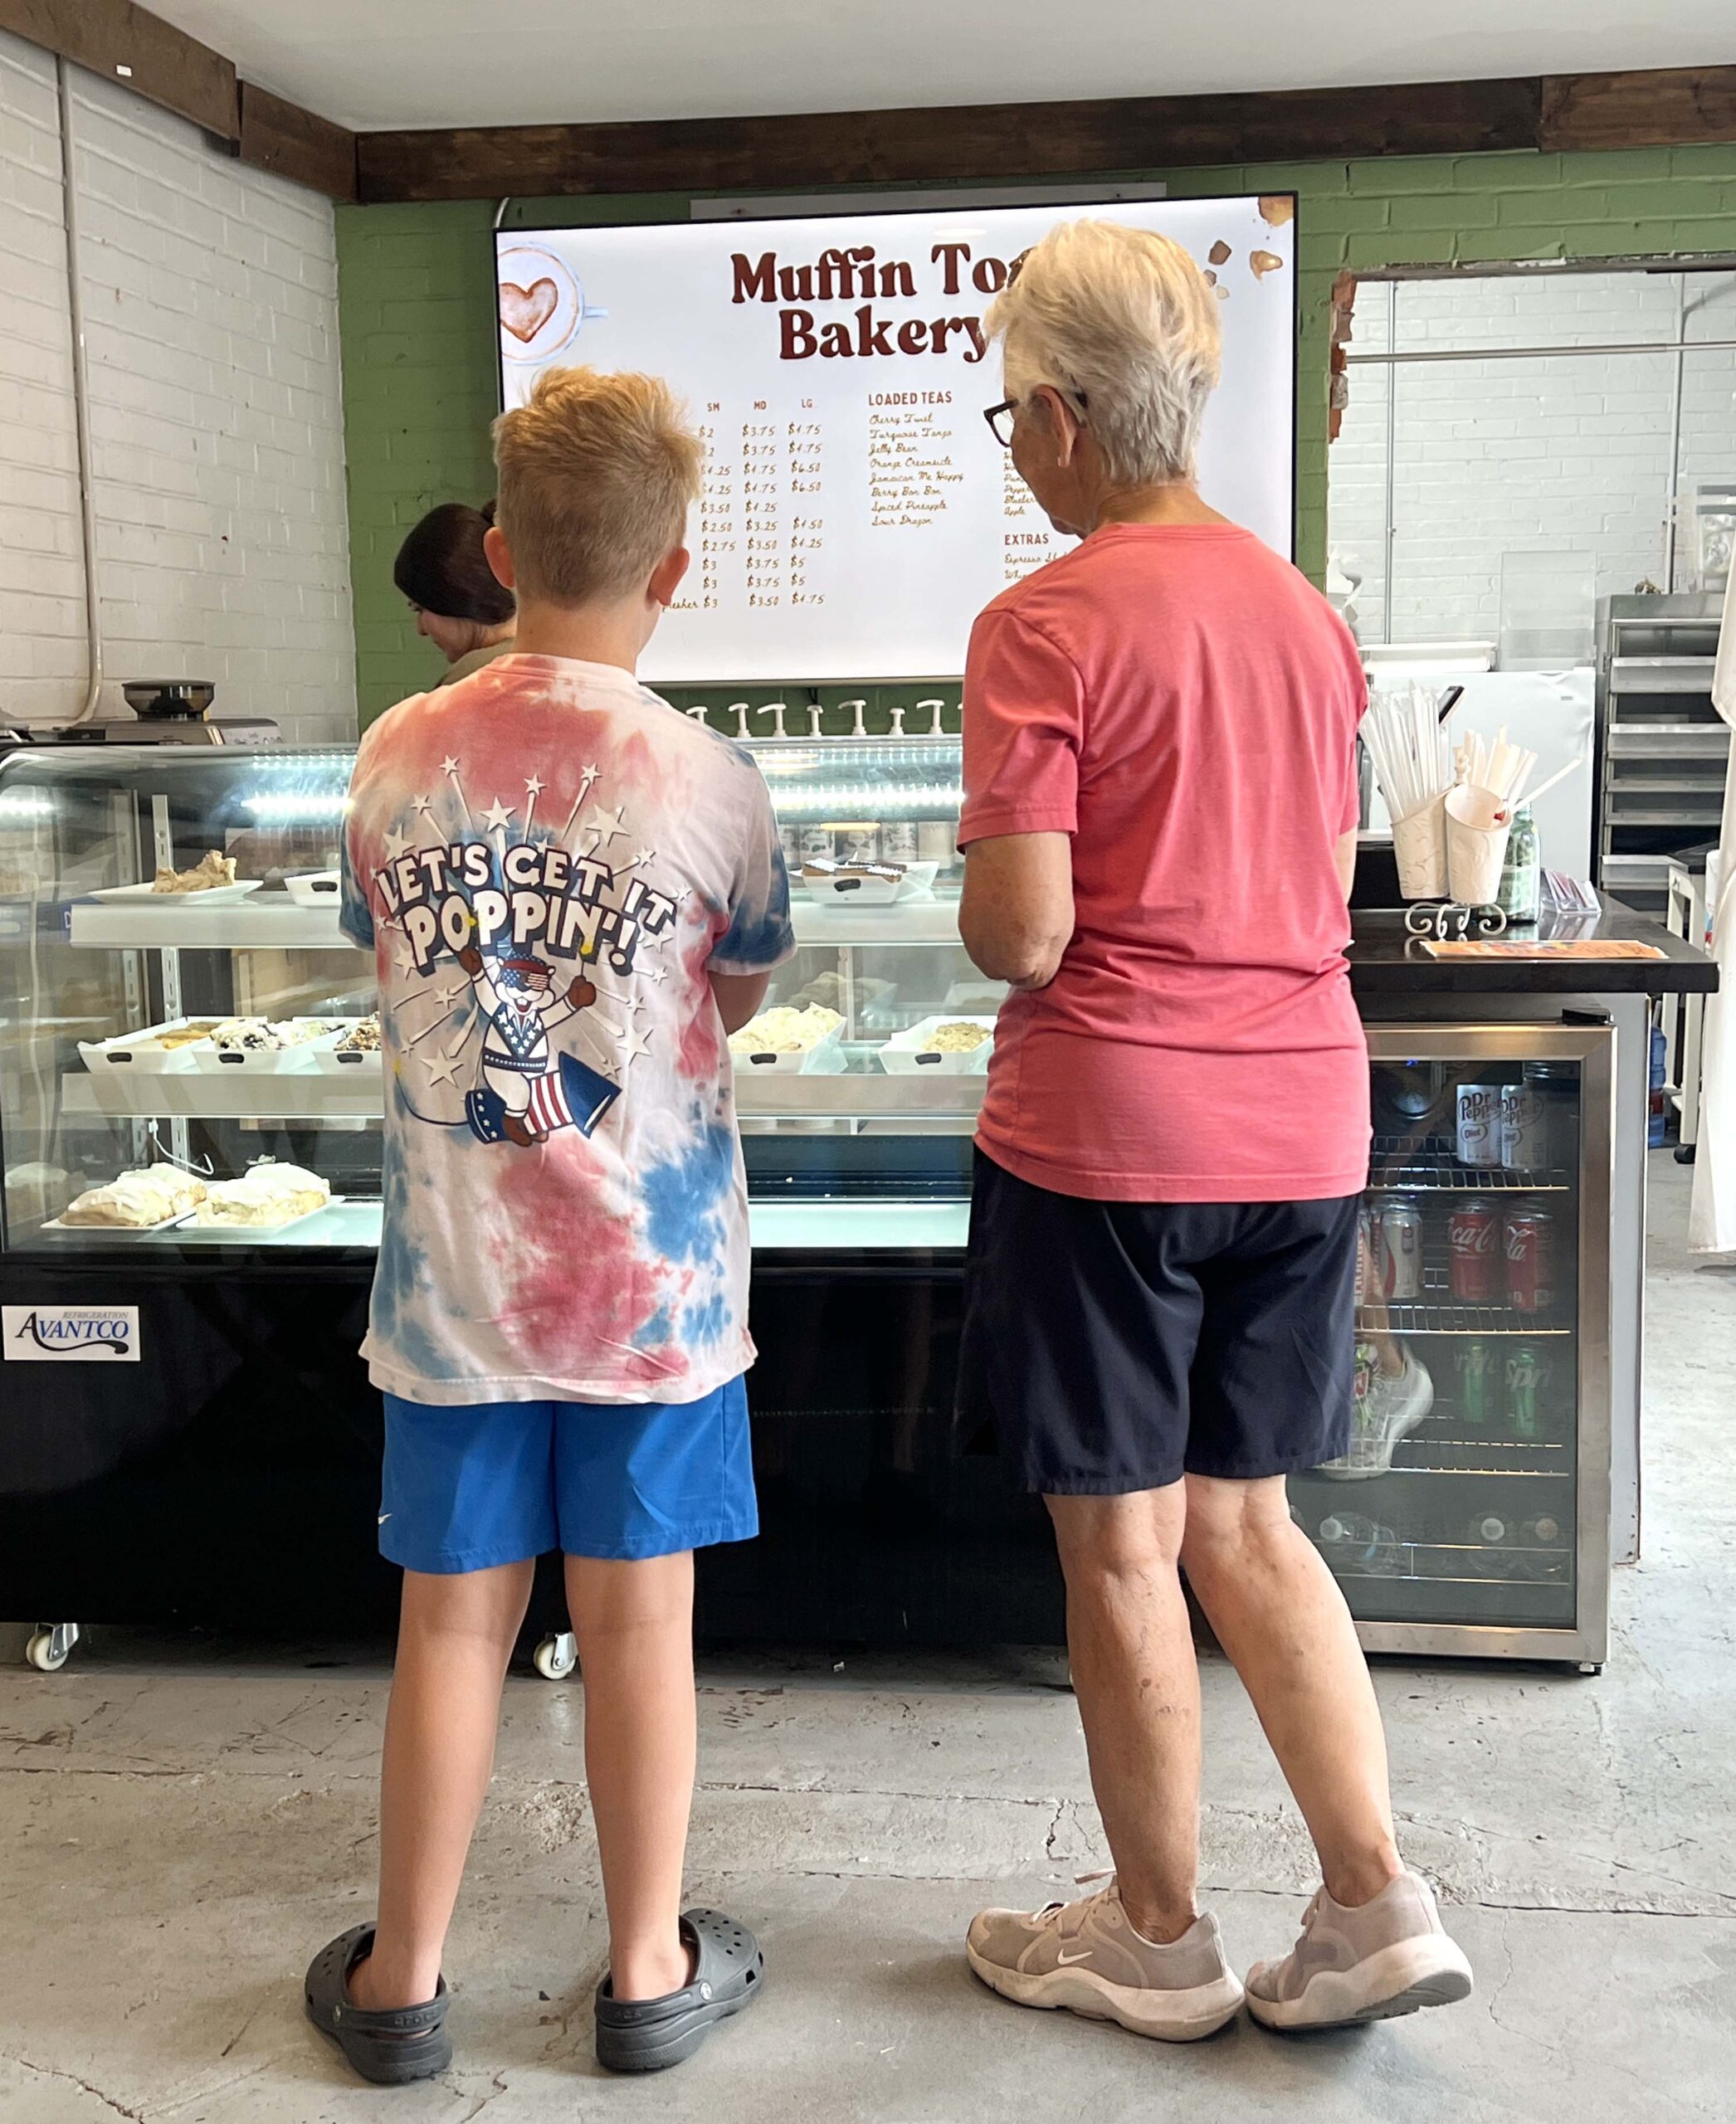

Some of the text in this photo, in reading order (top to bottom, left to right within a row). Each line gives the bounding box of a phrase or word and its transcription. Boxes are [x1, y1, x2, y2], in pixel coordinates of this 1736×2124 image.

[730, 246, 918, 304] Muffin
[778, 304, 989, 363] Bakery
[869, 391, 952, 406] LOADED TEAS
[708, 399, 812, 412] SM MD LG
[699, 425, 714, 438] $2
[743, 423, 775, 437] $3.75
[743, 442, 776, 456] $3.75
[868, 443, 917, 456] Jelly Bean
[870, 458, 901, 470] Orange
[936, 471, 963, 481] Happy
[871, 485, 941, 499] Berry Bon Bon
[905, 499, 947, 511] Pineapple
[1004, 506, 1026, 516] Apple
[900, 514, 932, 527] Dragon
[1005, 533, 1049, 545] EXTRAS
[703, 558, 716, 571] $3
[791, 554, 805, 568] $5
[1005, 553, 1041, 565] Espresso
[704, 576, 717, 589] $3
[791, 572, 805, 586] $5
[704, 595, 717, 608] $3
[377, 842, 677, 935] LET'S GET IT
[402, 888, 642, 977] POPPIN'!
[1471, 1092, 1492, 1104] Dr
[62, 1311, 129, 1319] REFRIGERATION
[14, 1311, 129, 1355] AVANTCO
